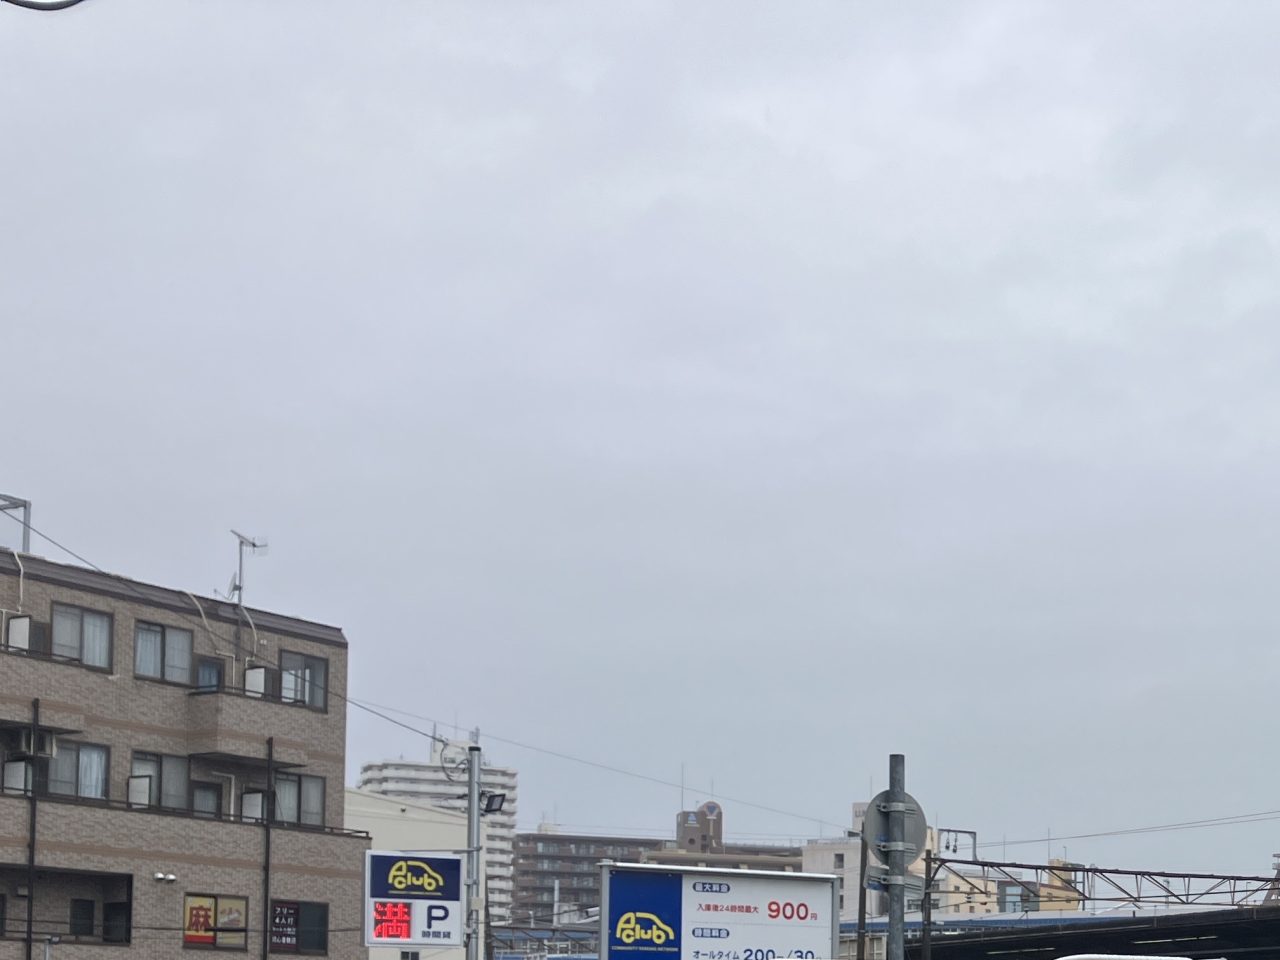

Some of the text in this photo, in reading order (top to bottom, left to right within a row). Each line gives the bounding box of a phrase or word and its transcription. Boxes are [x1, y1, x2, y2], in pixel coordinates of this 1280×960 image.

[275, 907, 294, 915] フリー
[427, 905, 450, 930] P
[692, 950, 739, 960] オールタイム
